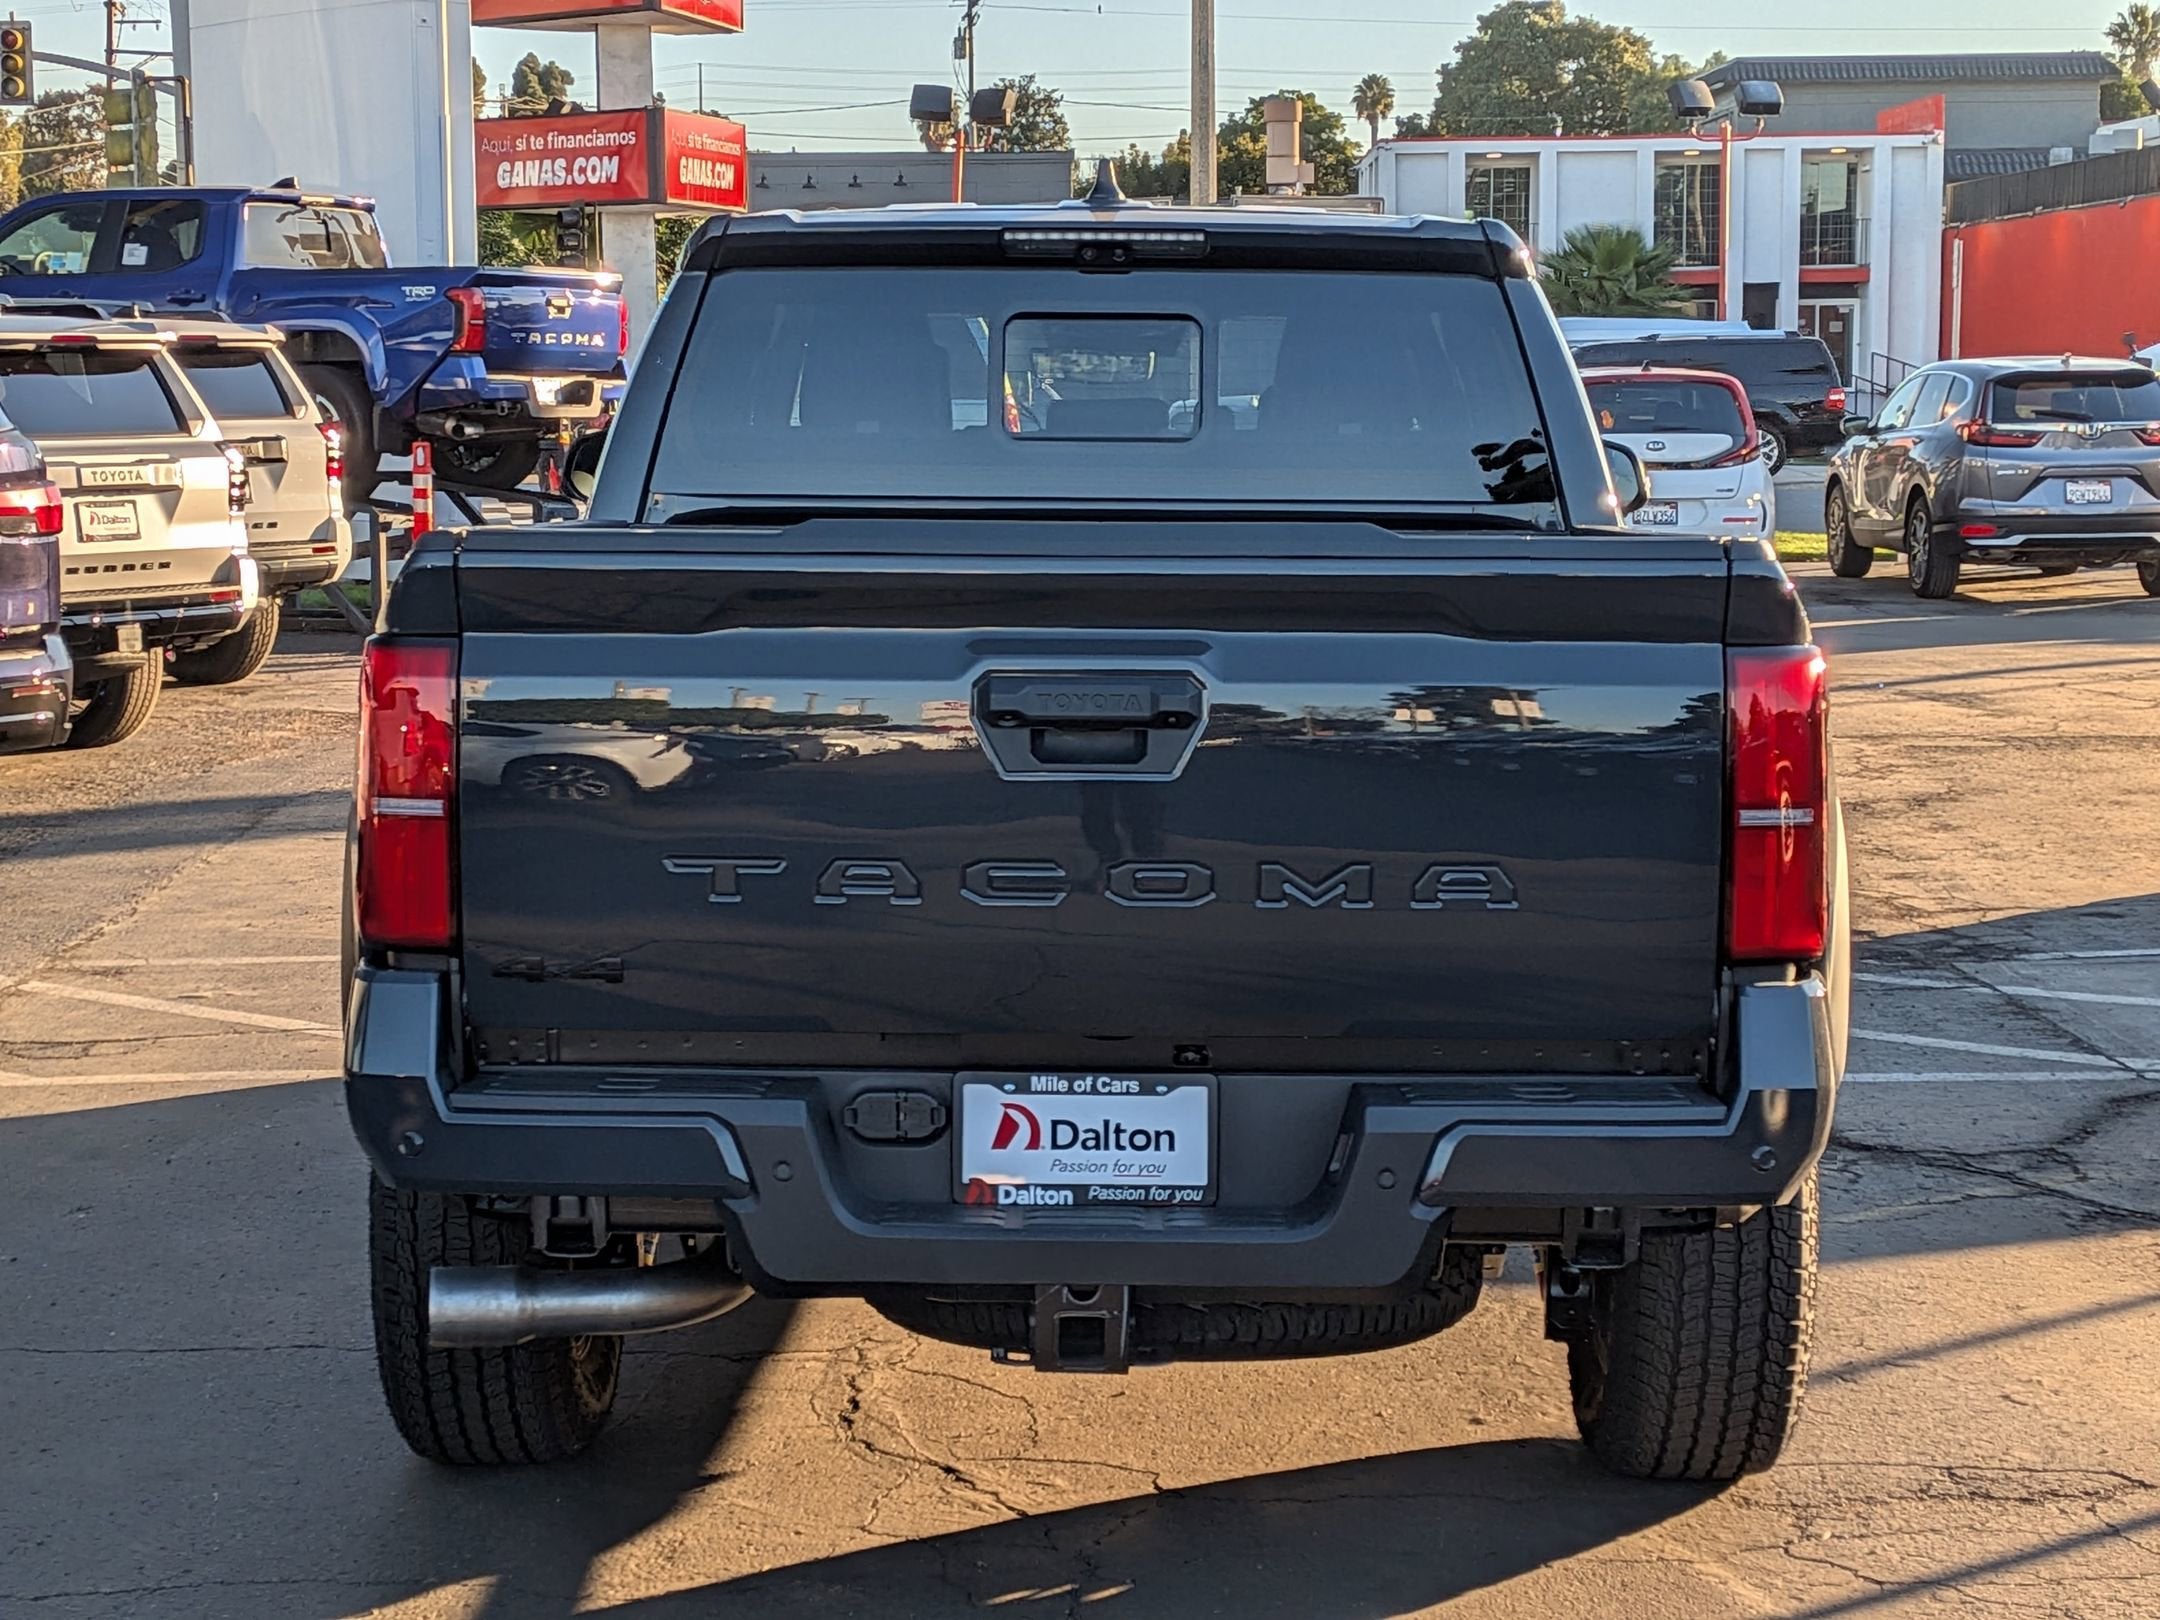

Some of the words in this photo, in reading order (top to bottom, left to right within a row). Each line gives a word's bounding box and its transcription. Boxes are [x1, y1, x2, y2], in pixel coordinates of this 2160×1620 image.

[530, 134, 544, 150] te
[547, 129, 636, 149] financiamos
[702, 133, 741, 156] financiamos
[497, 156, 619, 188] GANAS.COM
[680, 155, 734, 191] GANAS.COM
[401, 285, 436, 297] TRD
[510, 332, 605, 347] TACOMA
[91, 470, 143, 482] TOYOTA
[102, 515, 131, 524] Dalton
[1036, 692, 1145, 712] TOYOTA
[660, 857, 1520, 911] TACOMA
[1030, 1075, 1068, 1093] Mile
[1073, 1076, 1093, 1093] of
[1096, 1077, 1140, 1094] Cars
[1050, 1119, 1175, 1152] Dalton
[1050, 1158, 1108, 1173] Passion
[1113, 1159, 1135, 1174] for
[1138, 1162, 1167, 1175] you
[998, 1185, 1074, 1206] Dalton
[1087, 1186, 1146, 1201] Passion
[1148, 1186, 1172, 1201] for
[1174, 1189, 1203, 1203] you
